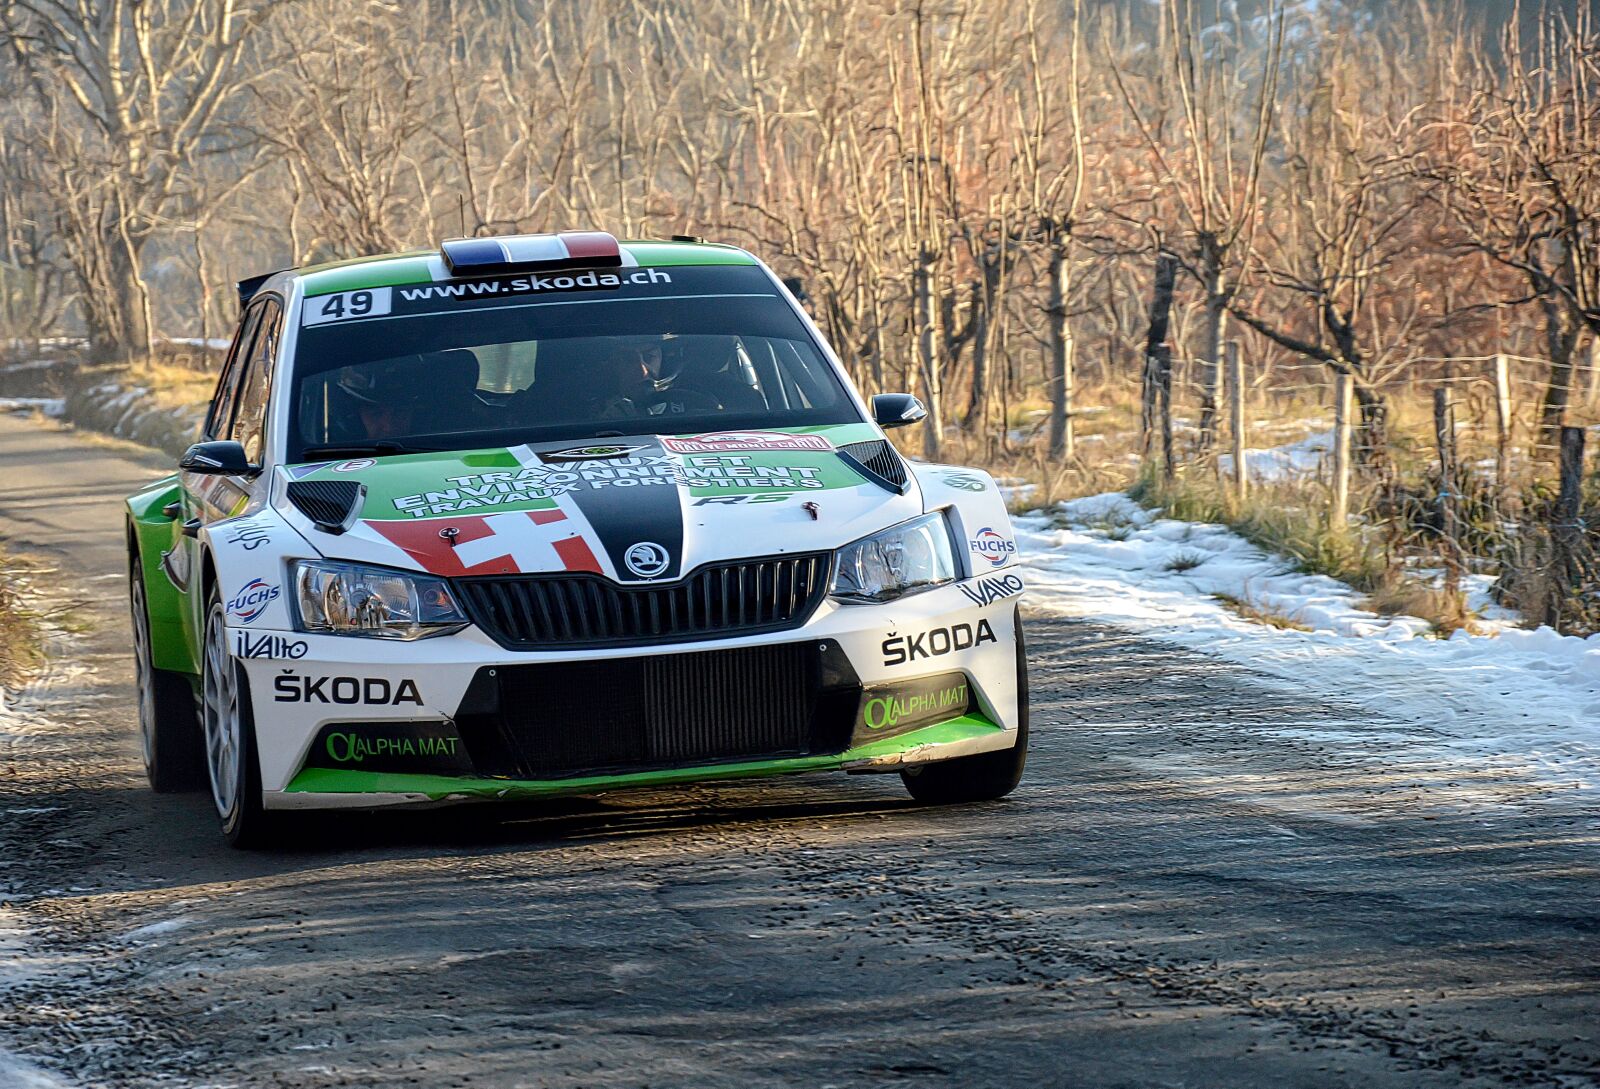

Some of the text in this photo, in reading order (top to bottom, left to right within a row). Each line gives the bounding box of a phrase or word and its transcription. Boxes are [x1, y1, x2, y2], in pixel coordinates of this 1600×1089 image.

[400, 268, 672, 301] www.skoda.ch
[321, 290, 373, 318] 49
[446, 455, 751, 487] TRAVAUX ET
[392, 466, 821, 510] ENVIRONNEMENT
[403, 477, 824, 518] TRAVAUX FORESTIERS
[691, 493, 794, 506] R5
[970, 540, 1015, 552] FUCHS
[226, 583, 281, 613] FUCHS
[881, 618, 998, 667] ŠKODA
[273, 669, 425, 707] ŠKODA
[939, 684, 967, 707] MAT
[417, 737, 459, 756] MAT
